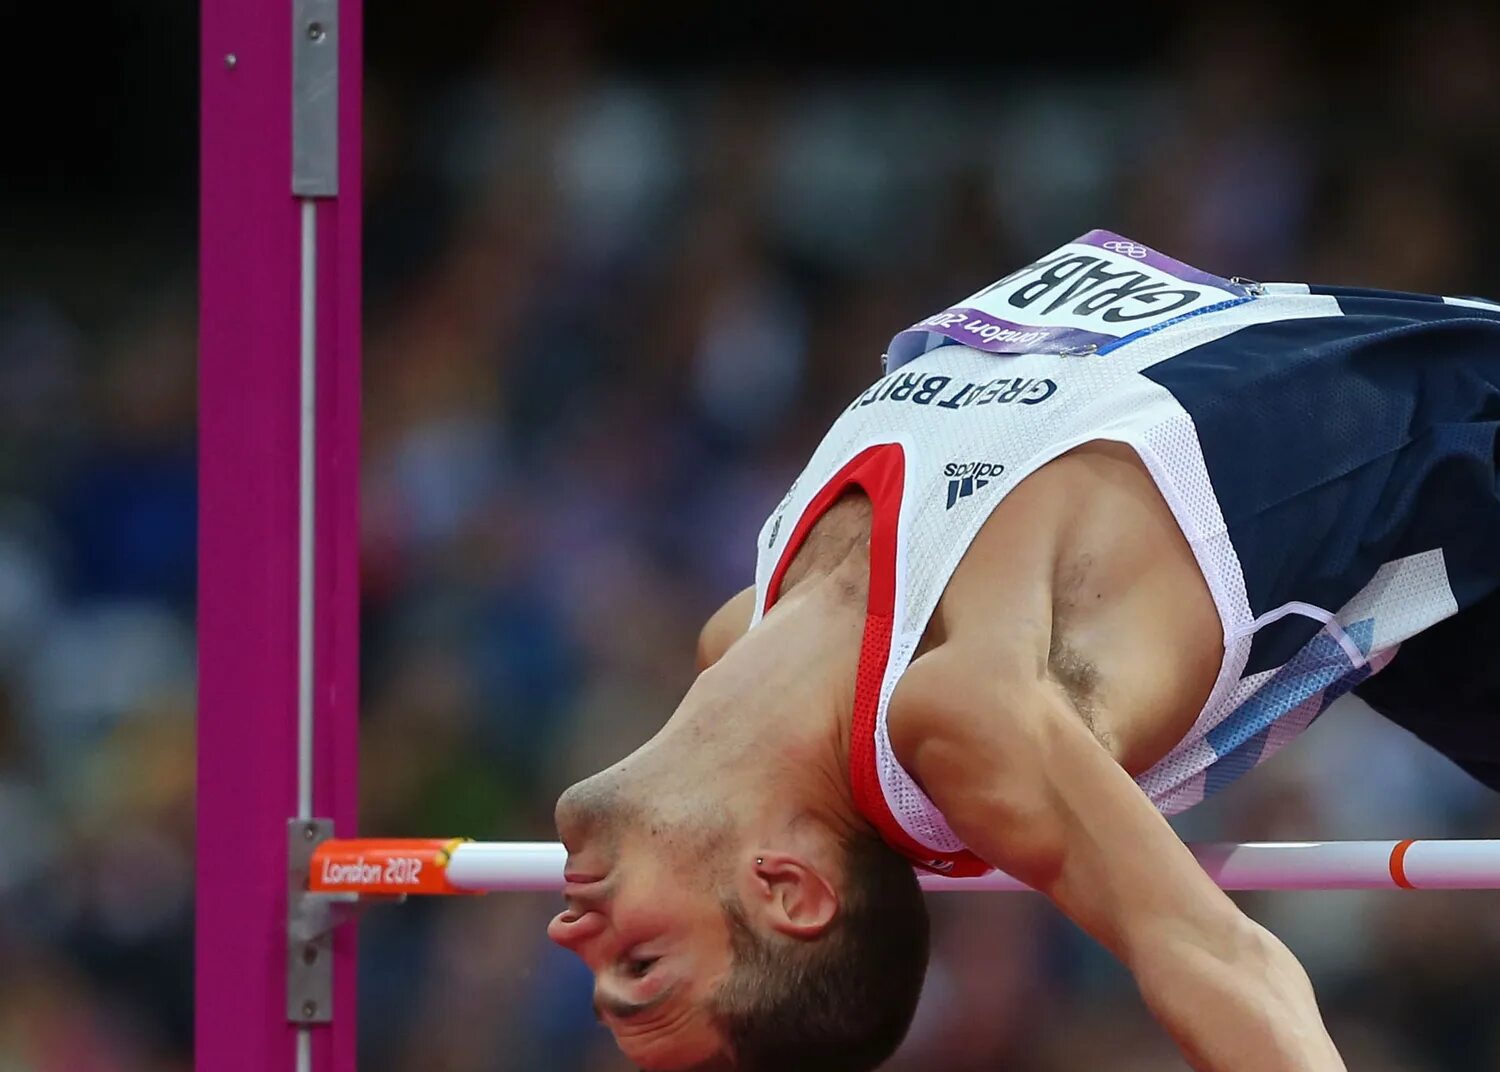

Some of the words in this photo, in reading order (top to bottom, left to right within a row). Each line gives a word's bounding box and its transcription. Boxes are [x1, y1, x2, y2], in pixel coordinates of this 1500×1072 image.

[963, 319, 1050, 345] London
[937, 378, 1058, 410] GREAT
[944, 462, 1004, 480] adidas
[323, 857, 382, 884] London
[386, 857, 422, 884] 2012
